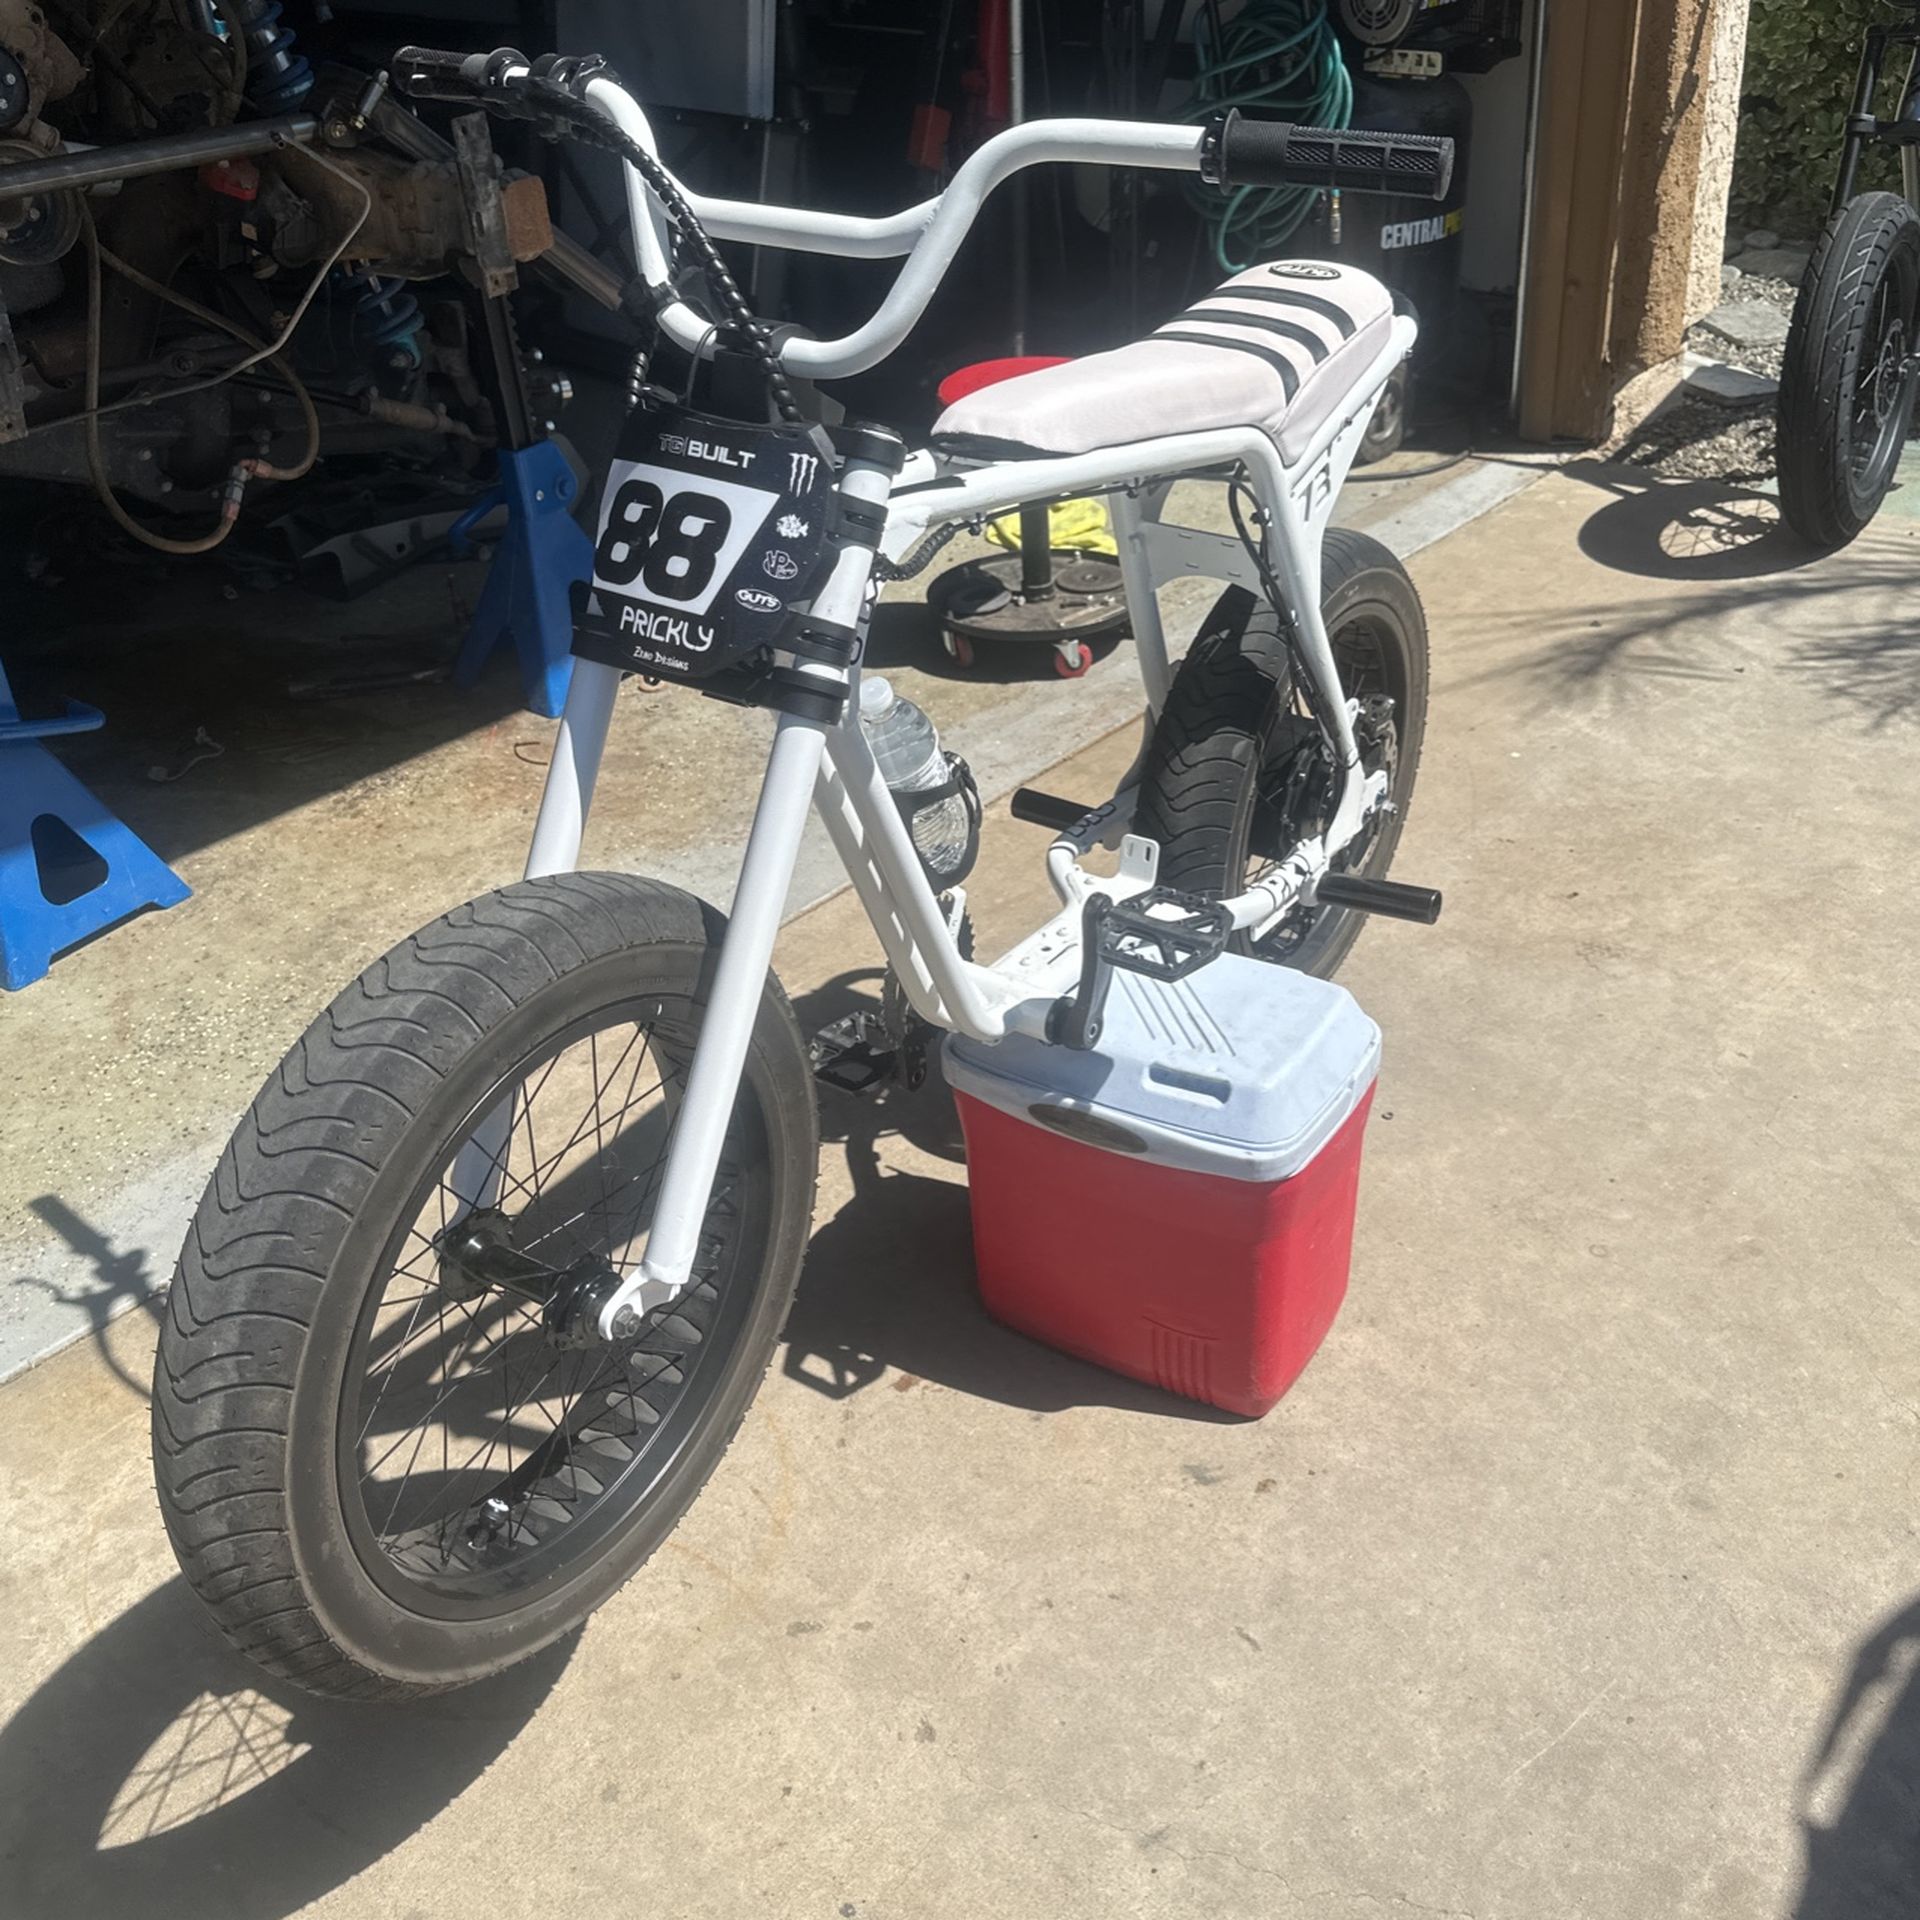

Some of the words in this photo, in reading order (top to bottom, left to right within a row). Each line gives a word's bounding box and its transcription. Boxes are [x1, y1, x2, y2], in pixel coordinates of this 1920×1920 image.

[1380, 214, 1447, 250] CENTRAL
[687, 439, 756, 468] BUILT
[595, 479, 732, 602] 88
[738, 590, 778, 609] GUTS
[620, 605, 714, 652] PRICKLY
